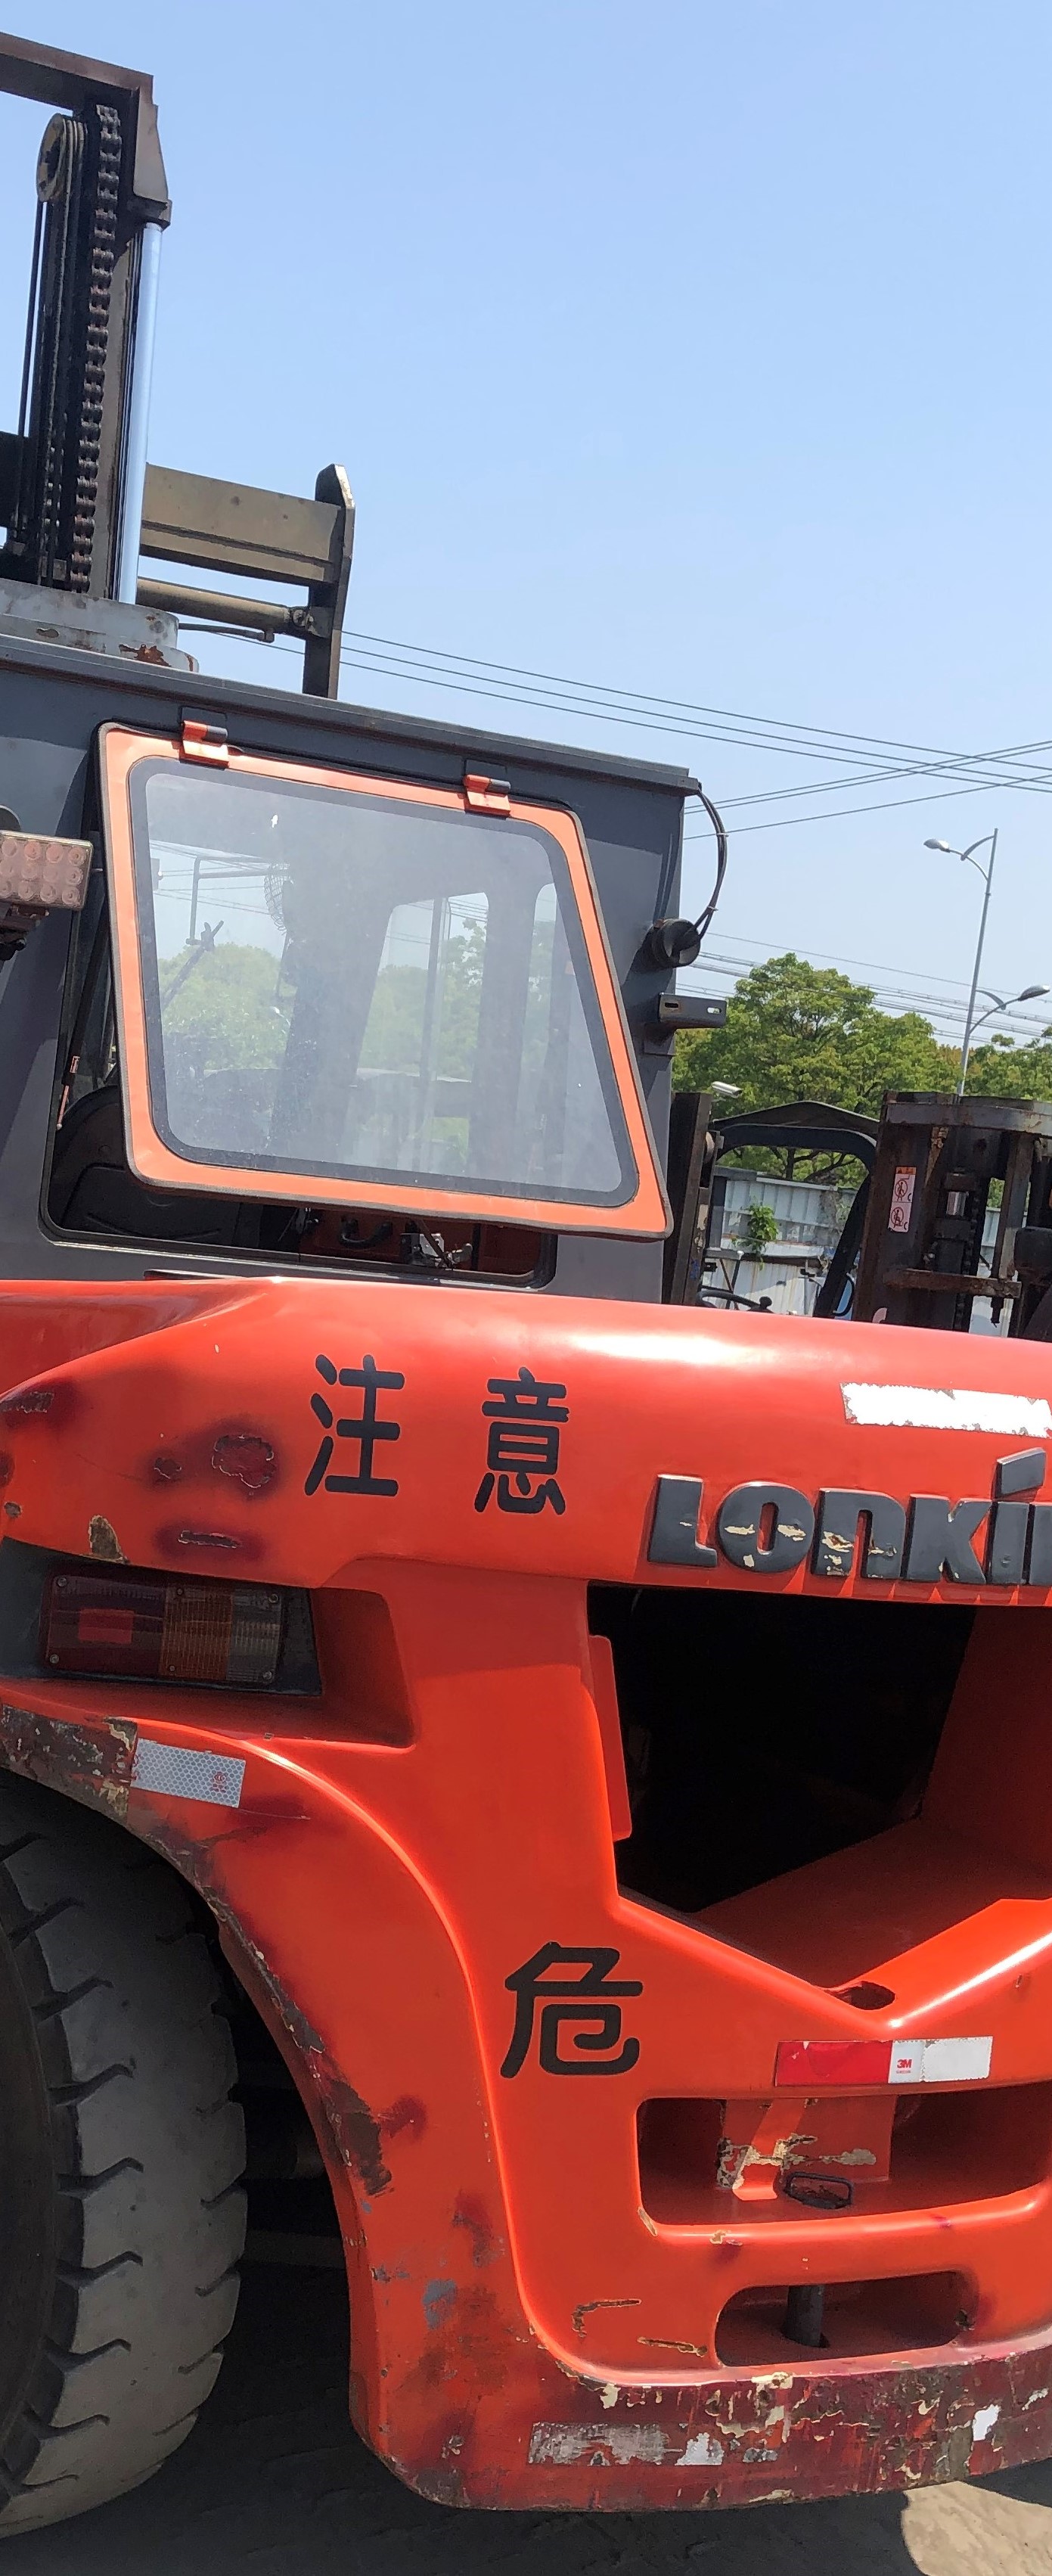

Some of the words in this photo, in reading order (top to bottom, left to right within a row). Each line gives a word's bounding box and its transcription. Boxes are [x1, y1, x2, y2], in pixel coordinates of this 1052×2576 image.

[305, 1354, 569, 1515] 注意
[501, 1941, 643, 2078] 危
[897, 2059, 912, 2068] 3M
